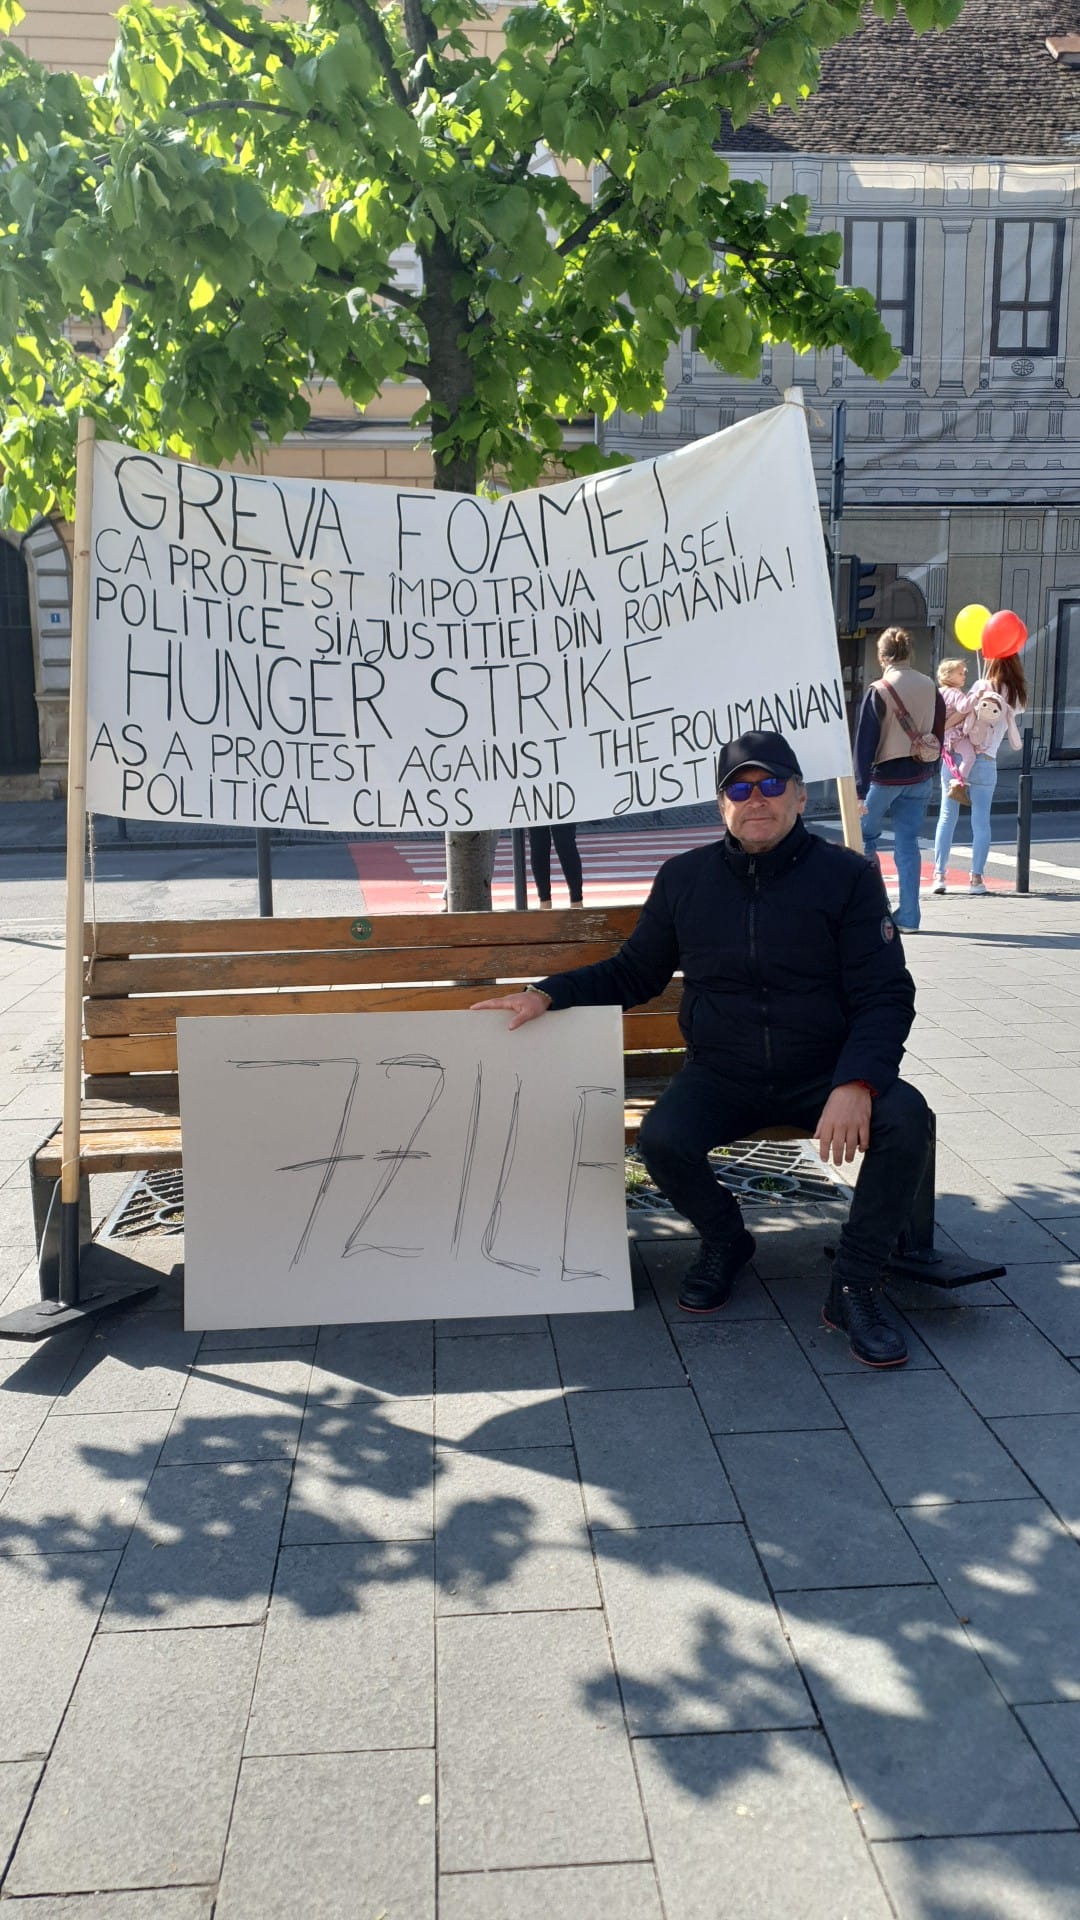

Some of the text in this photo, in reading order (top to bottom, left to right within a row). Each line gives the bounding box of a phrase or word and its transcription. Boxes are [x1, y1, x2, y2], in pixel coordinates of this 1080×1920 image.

[95, 528, 152, 581] CA
[168, 543, 366, 612] PROTEST
[617, 511, 737, 593] CLASEI
[114, 455, 353, 565] GREVA
[95, 576, 286, 651] POLITICE
[554, 607, 602, 652] DIN
[90, 678, 844, 784] AS A PROTEST AGAINST THE ROUMANIAN
[126, 633, 675, 740] HUNGER STRIKE
[122, 751, 720, 828] POLITICAL CLASS AND JUSTI
